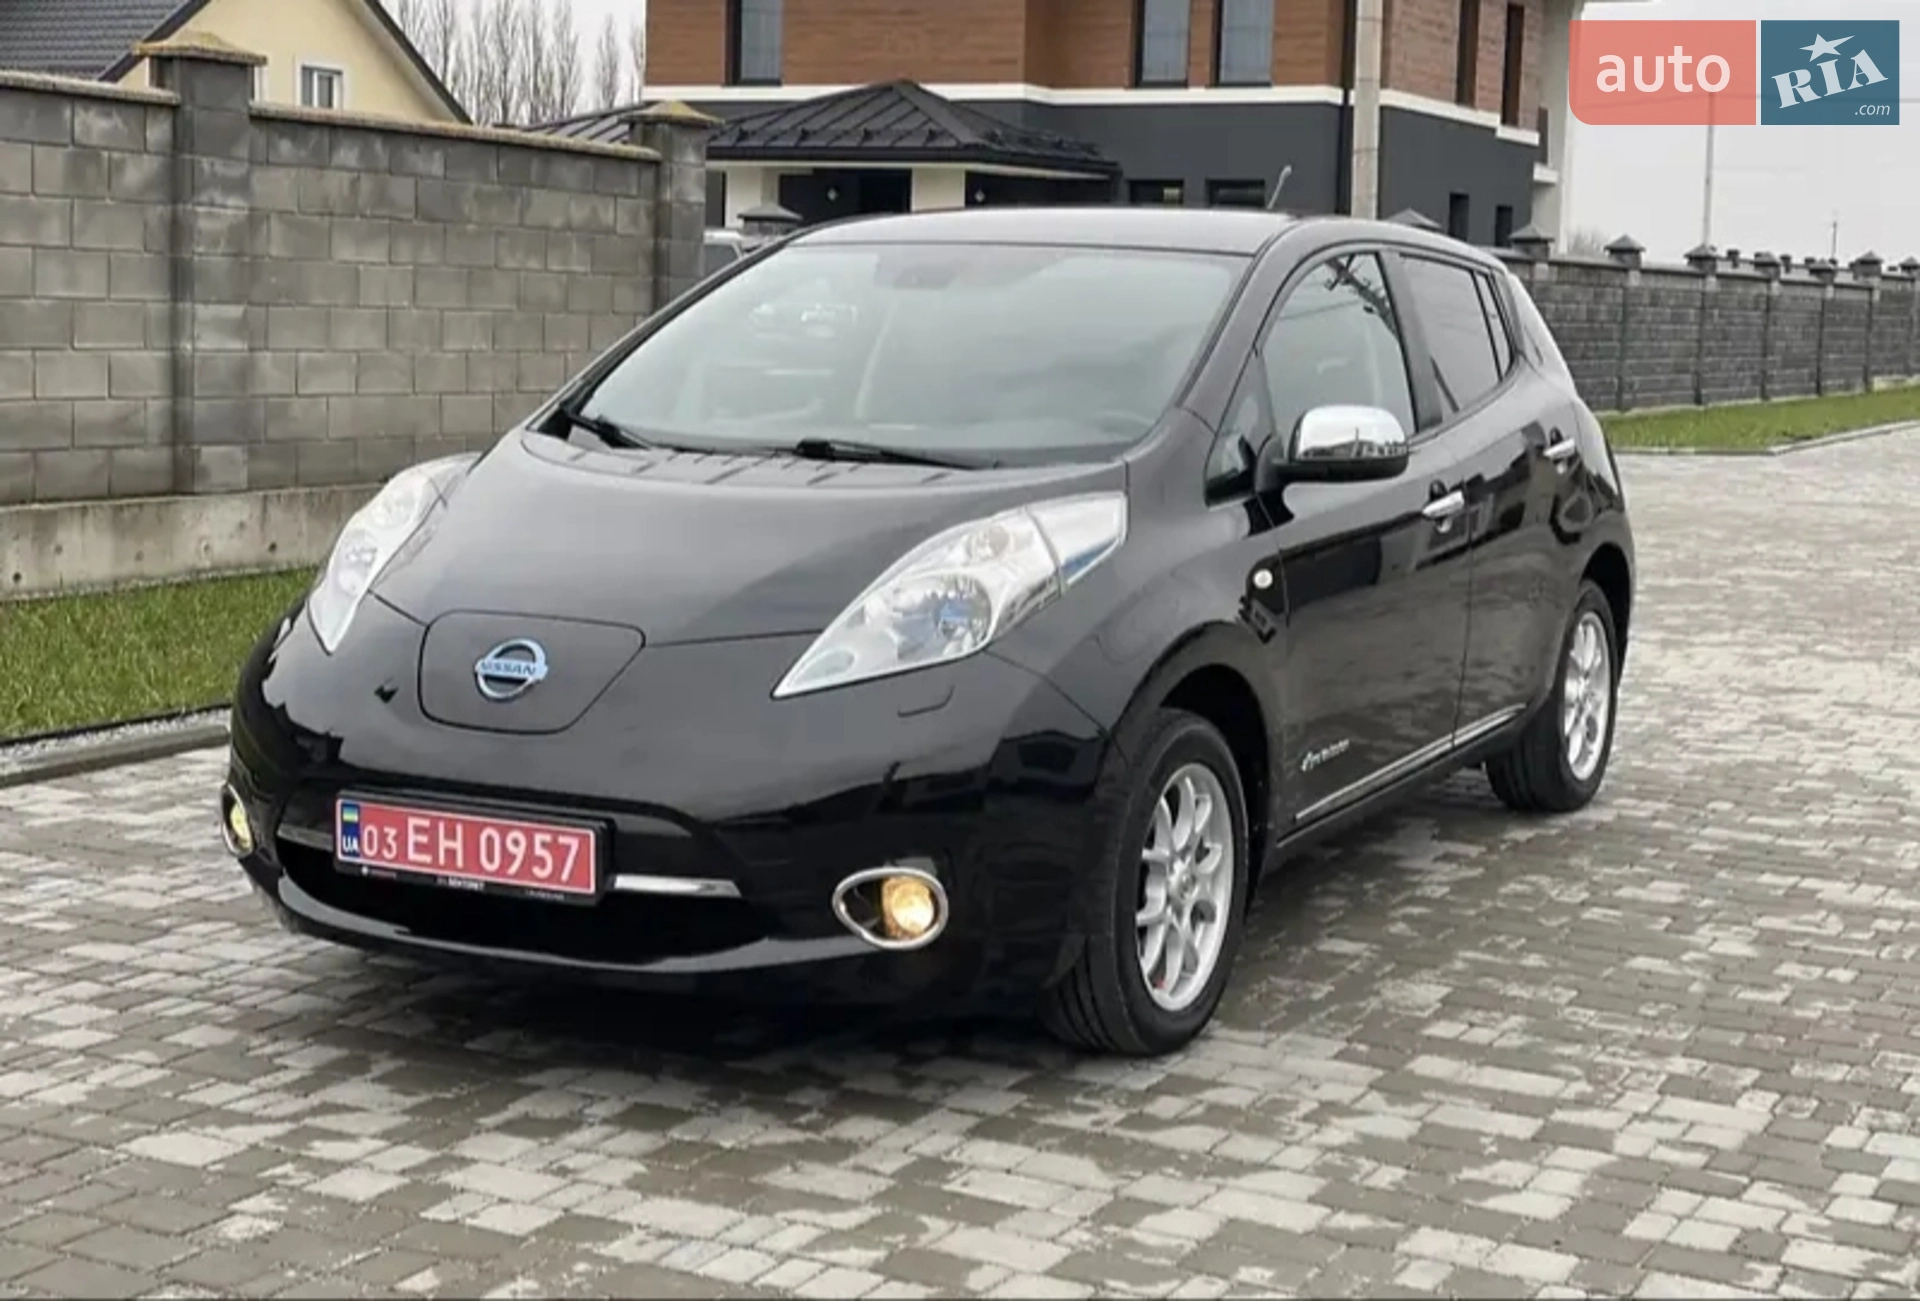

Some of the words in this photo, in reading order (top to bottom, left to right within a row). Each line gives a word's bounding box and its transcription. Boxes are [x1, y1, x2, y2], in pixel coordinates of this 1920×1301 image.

[343, 835, 359, 853] UA
[363, 825, 397, 859] 03
[407, 816, 464, 869] EH
[479, 826, 580, 882] 0957
